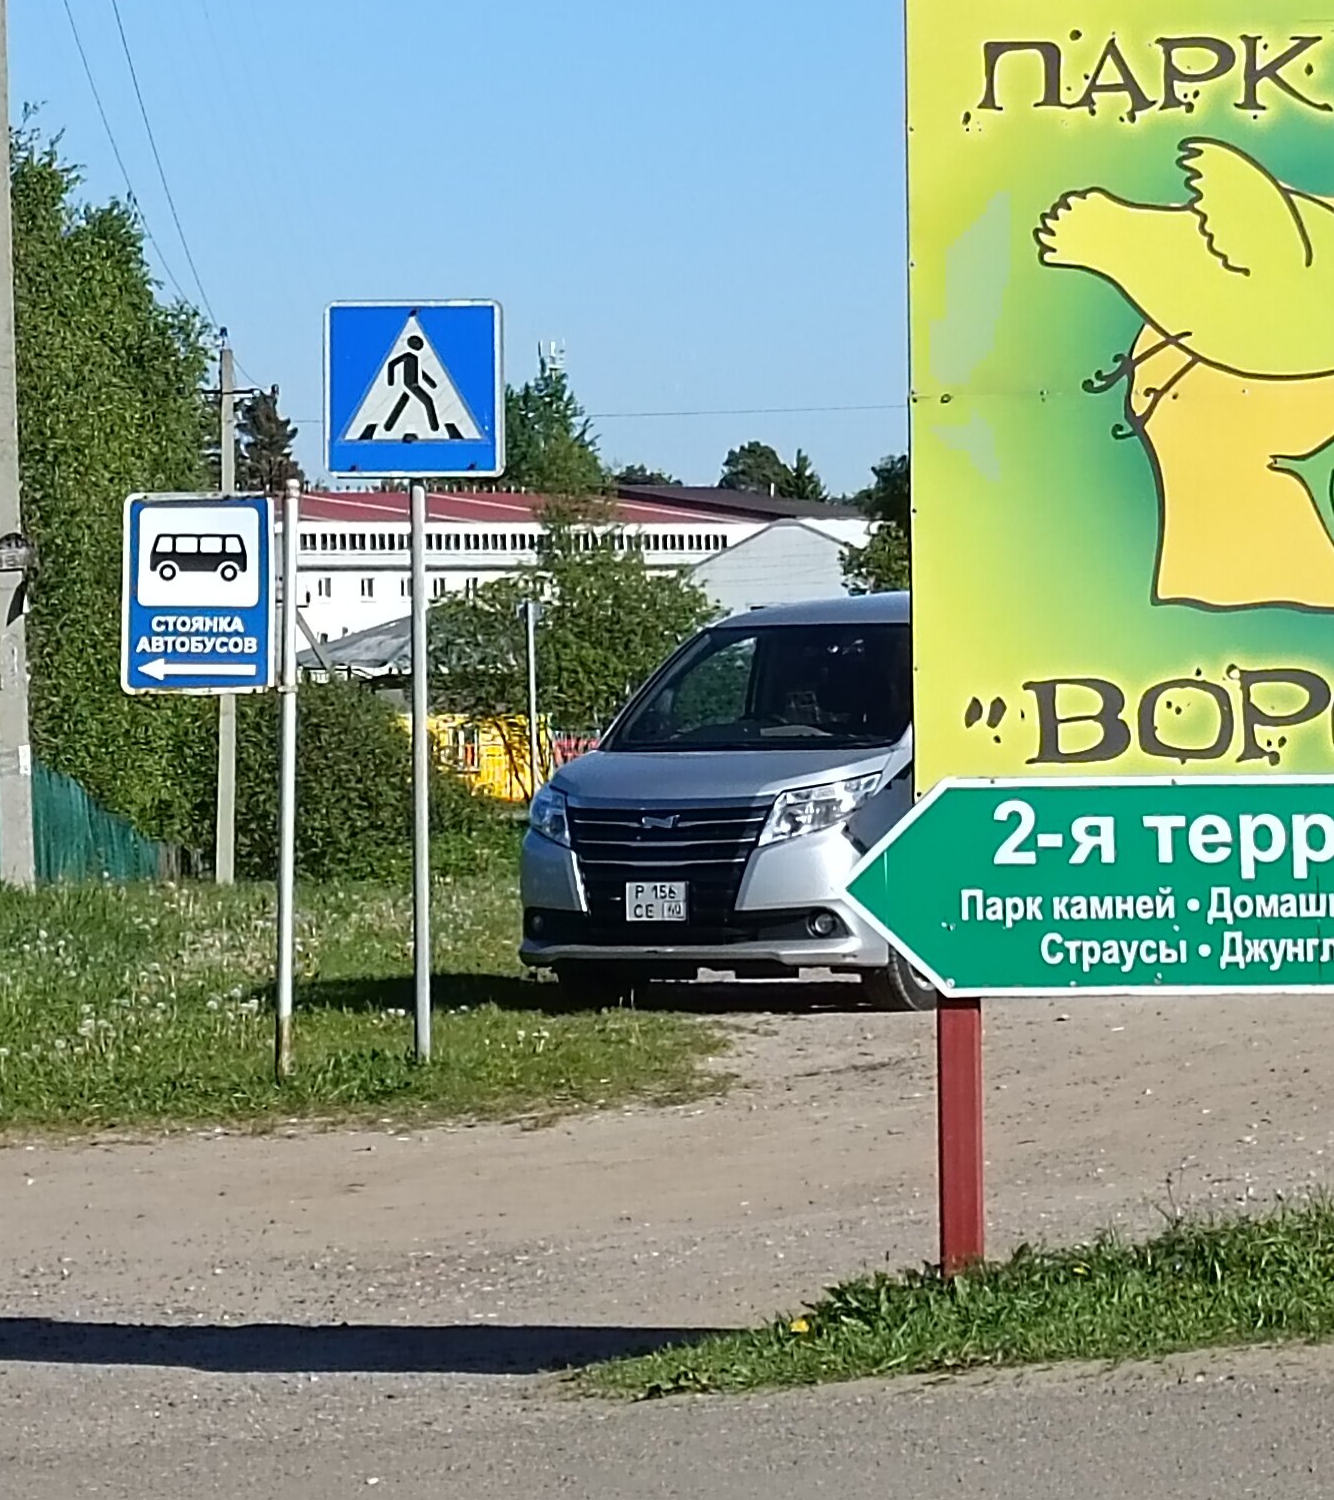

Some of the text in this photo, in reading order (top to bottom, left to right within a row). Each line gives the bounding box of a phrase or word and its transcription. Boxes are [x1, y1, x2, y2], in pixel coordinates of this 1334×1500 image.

[977, 33, 1334, 123] ПАРК
[151, 615, 245, 633] СТОЯНКА
[135, 636, 258, 654] АВТОБУСОВ
[992, 799, 1116, 865] 2-я
[960, 889, 1044, 928] Парк
[1051, 887, 1176, 921] камней
[1039, 932, 1188, 972] Страусы
